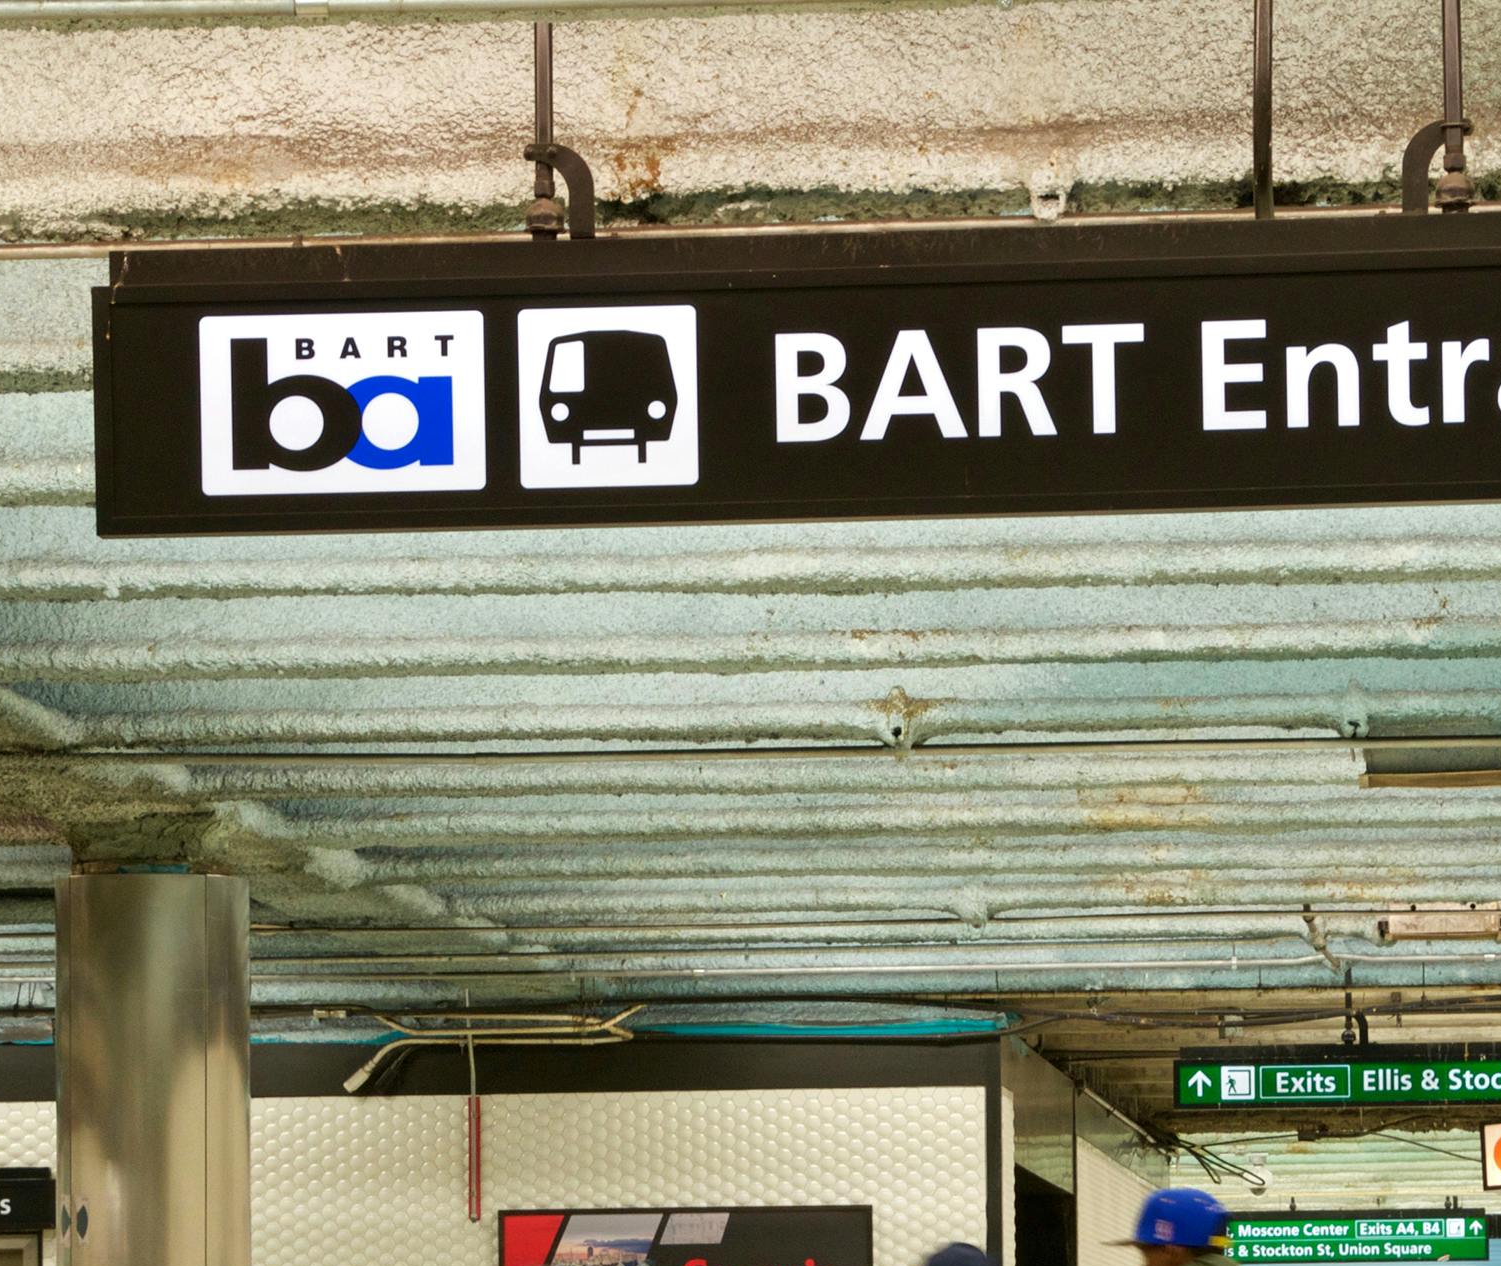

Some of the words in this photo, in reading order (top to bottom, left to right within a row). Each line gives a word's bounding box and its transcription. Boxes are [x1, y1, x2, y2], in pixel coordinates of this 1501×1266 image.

[296, 333, 455, 361] BART
[773, 322, 1145, 445] BART
[1275, 1071, 1336, 1093] Exits
[1362, 1068, 1412, 1091] Ellis
[1420, 1068, 1440, 1091] &
[1238, 1224, 1300, 1237] Moscone
[1303, 1222, 1349, 1236] Center
[1359, 1222, 1393, 1236] Exits
[1395, 1222, 1419, 1237] A4,
[1423, 1221, 1441, 1235] B4
[1238, 1245, 1249, 1257] &
[1252, 1243, 1313, 1256] Stockton
[1317, 1243, 1335, 1257] St,
[1339, 1243, 1381, 1256] Union
[1383, 1243, 1432, 1258] Square
